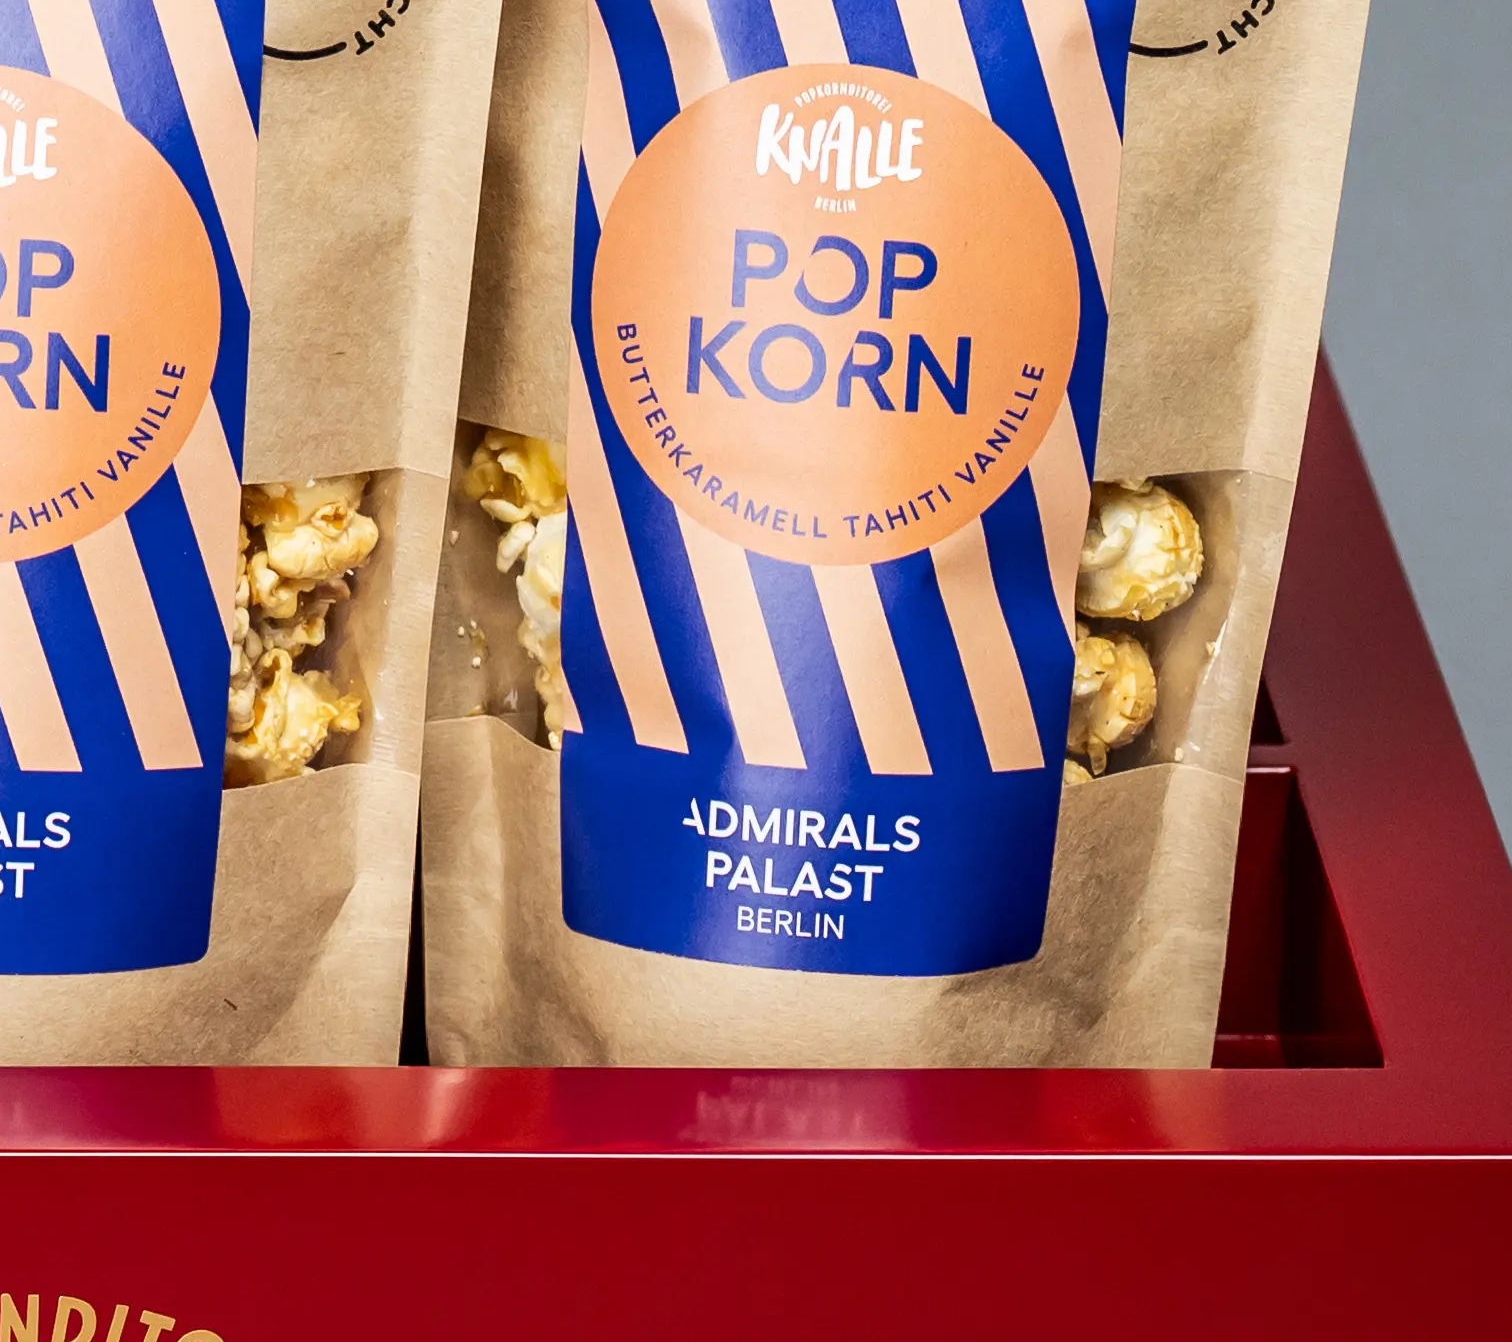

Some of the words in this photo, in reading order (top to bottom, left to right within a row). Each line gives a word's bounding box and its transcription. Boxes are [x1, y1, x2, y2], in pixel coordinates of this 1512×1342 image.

[755, 103, 924, 192] KNALLE
[814, 196, 857, 213] BERLIN
[730, 228, 939, 320] POP
[684, 315, 972, 416] KORN
[97, 360, 186, 486] VANILLE
[617, 323, 830, 540] BUTTERKARAMELL
[842, 482, 951, 539] TAHITI
[955, 361, 1046, 487] VANILLE
[682, 797, 921, 853] ADMIRALS
[705, 851, 884, 902] PALAST
[736, 906, 845, 940] BERLIN
